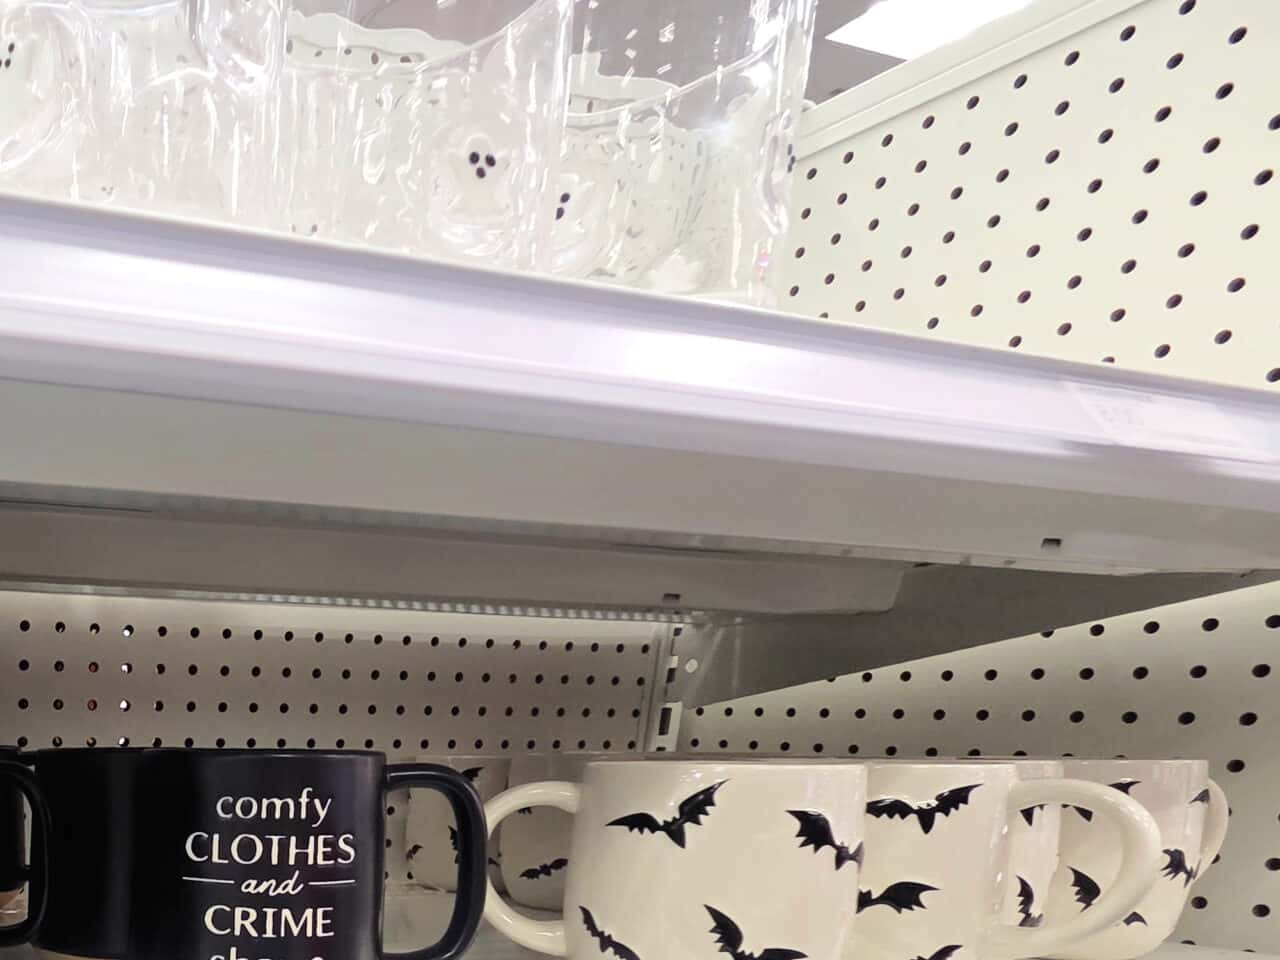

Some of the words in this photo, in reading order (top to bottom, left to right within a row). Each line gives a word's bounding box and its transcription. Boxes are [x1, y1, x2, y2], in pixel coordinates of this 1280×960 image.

[216, 787, 332, 828] comfy
[185, 831, 356, 866] CLOTHES
[241, 870, 304, 896] and
[204, 904, 335, 938] CRIME
